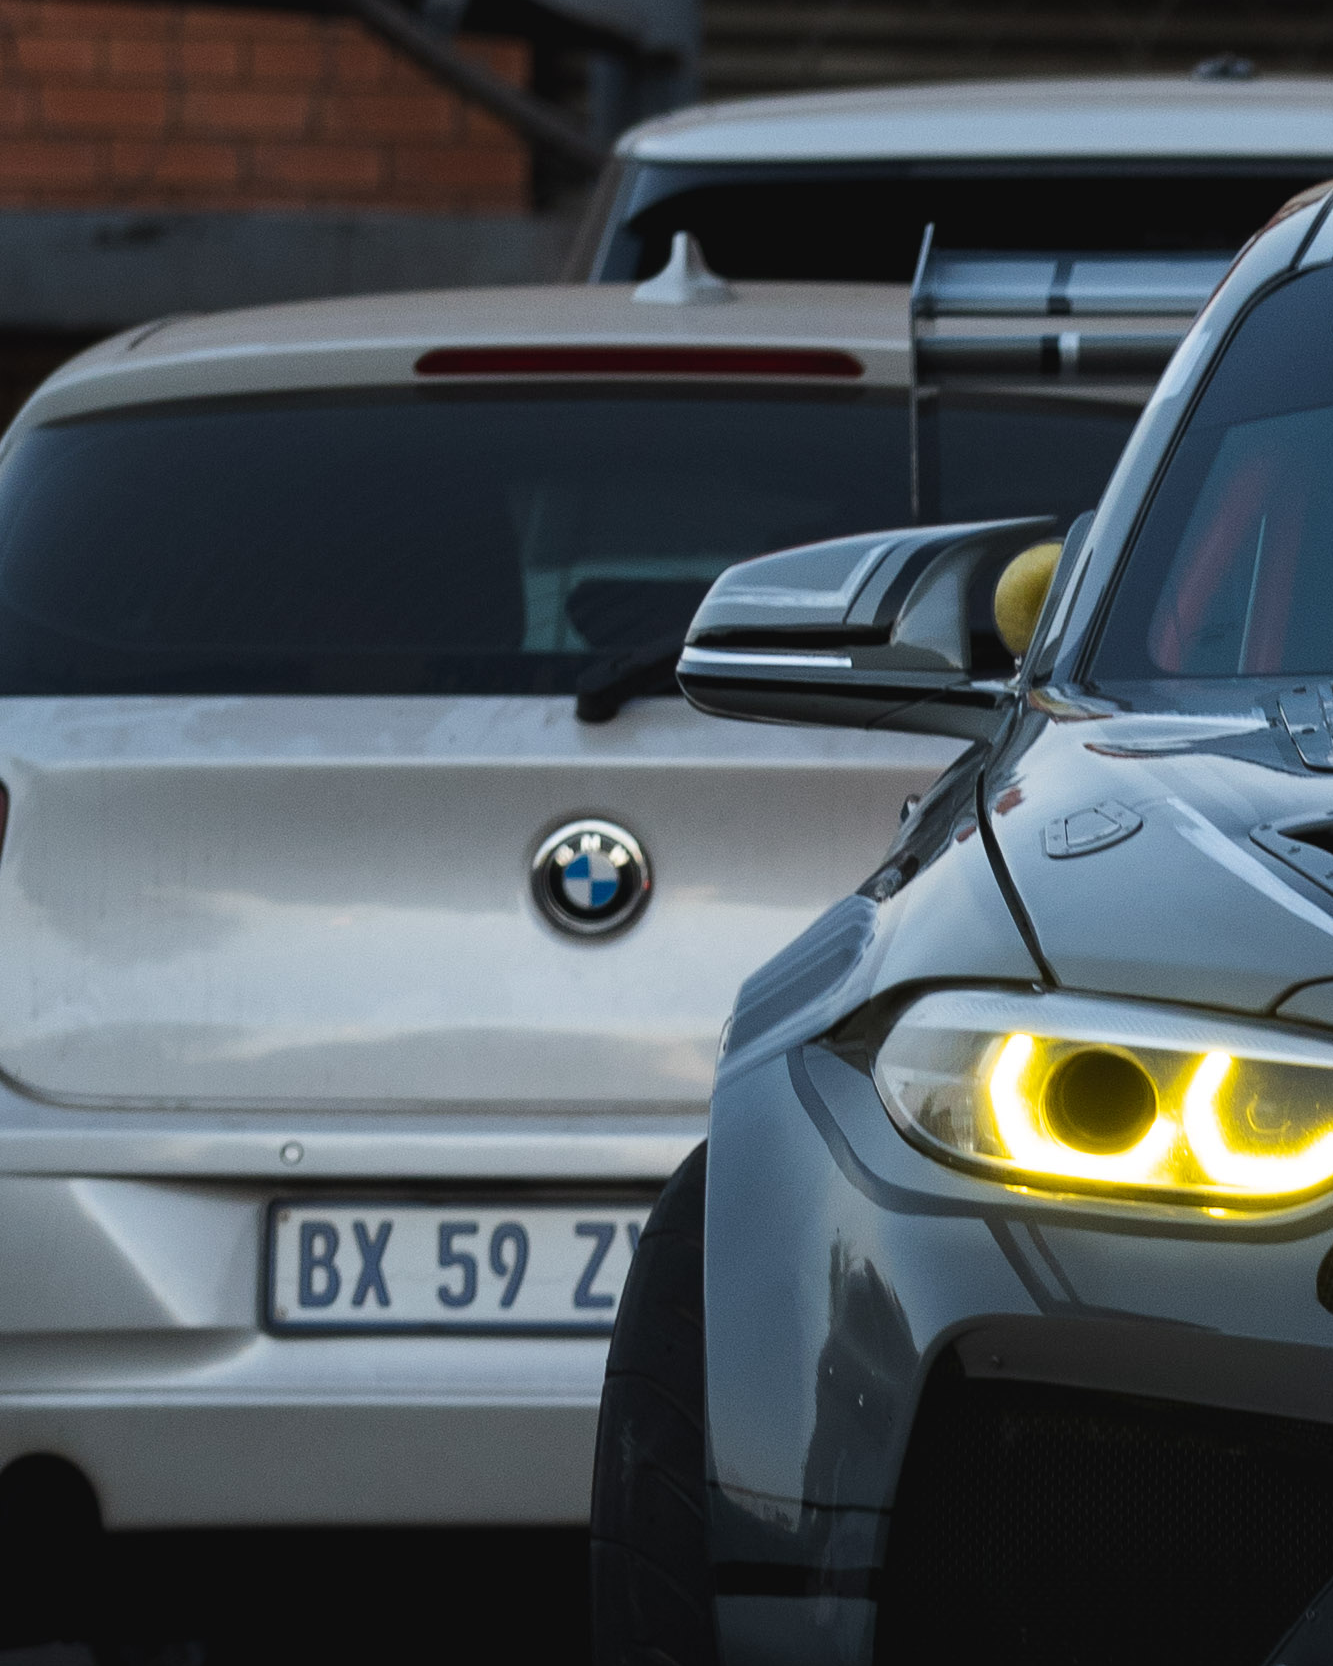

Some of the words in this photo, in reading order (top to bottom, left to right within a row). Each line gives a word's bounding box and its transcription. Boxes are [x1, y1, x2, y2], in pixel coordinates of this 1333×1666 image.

[298, 1221, 394, 1310] BX
[436, 1221, 530, 1311] 59
[572, 1221, 642, 1311] Z
